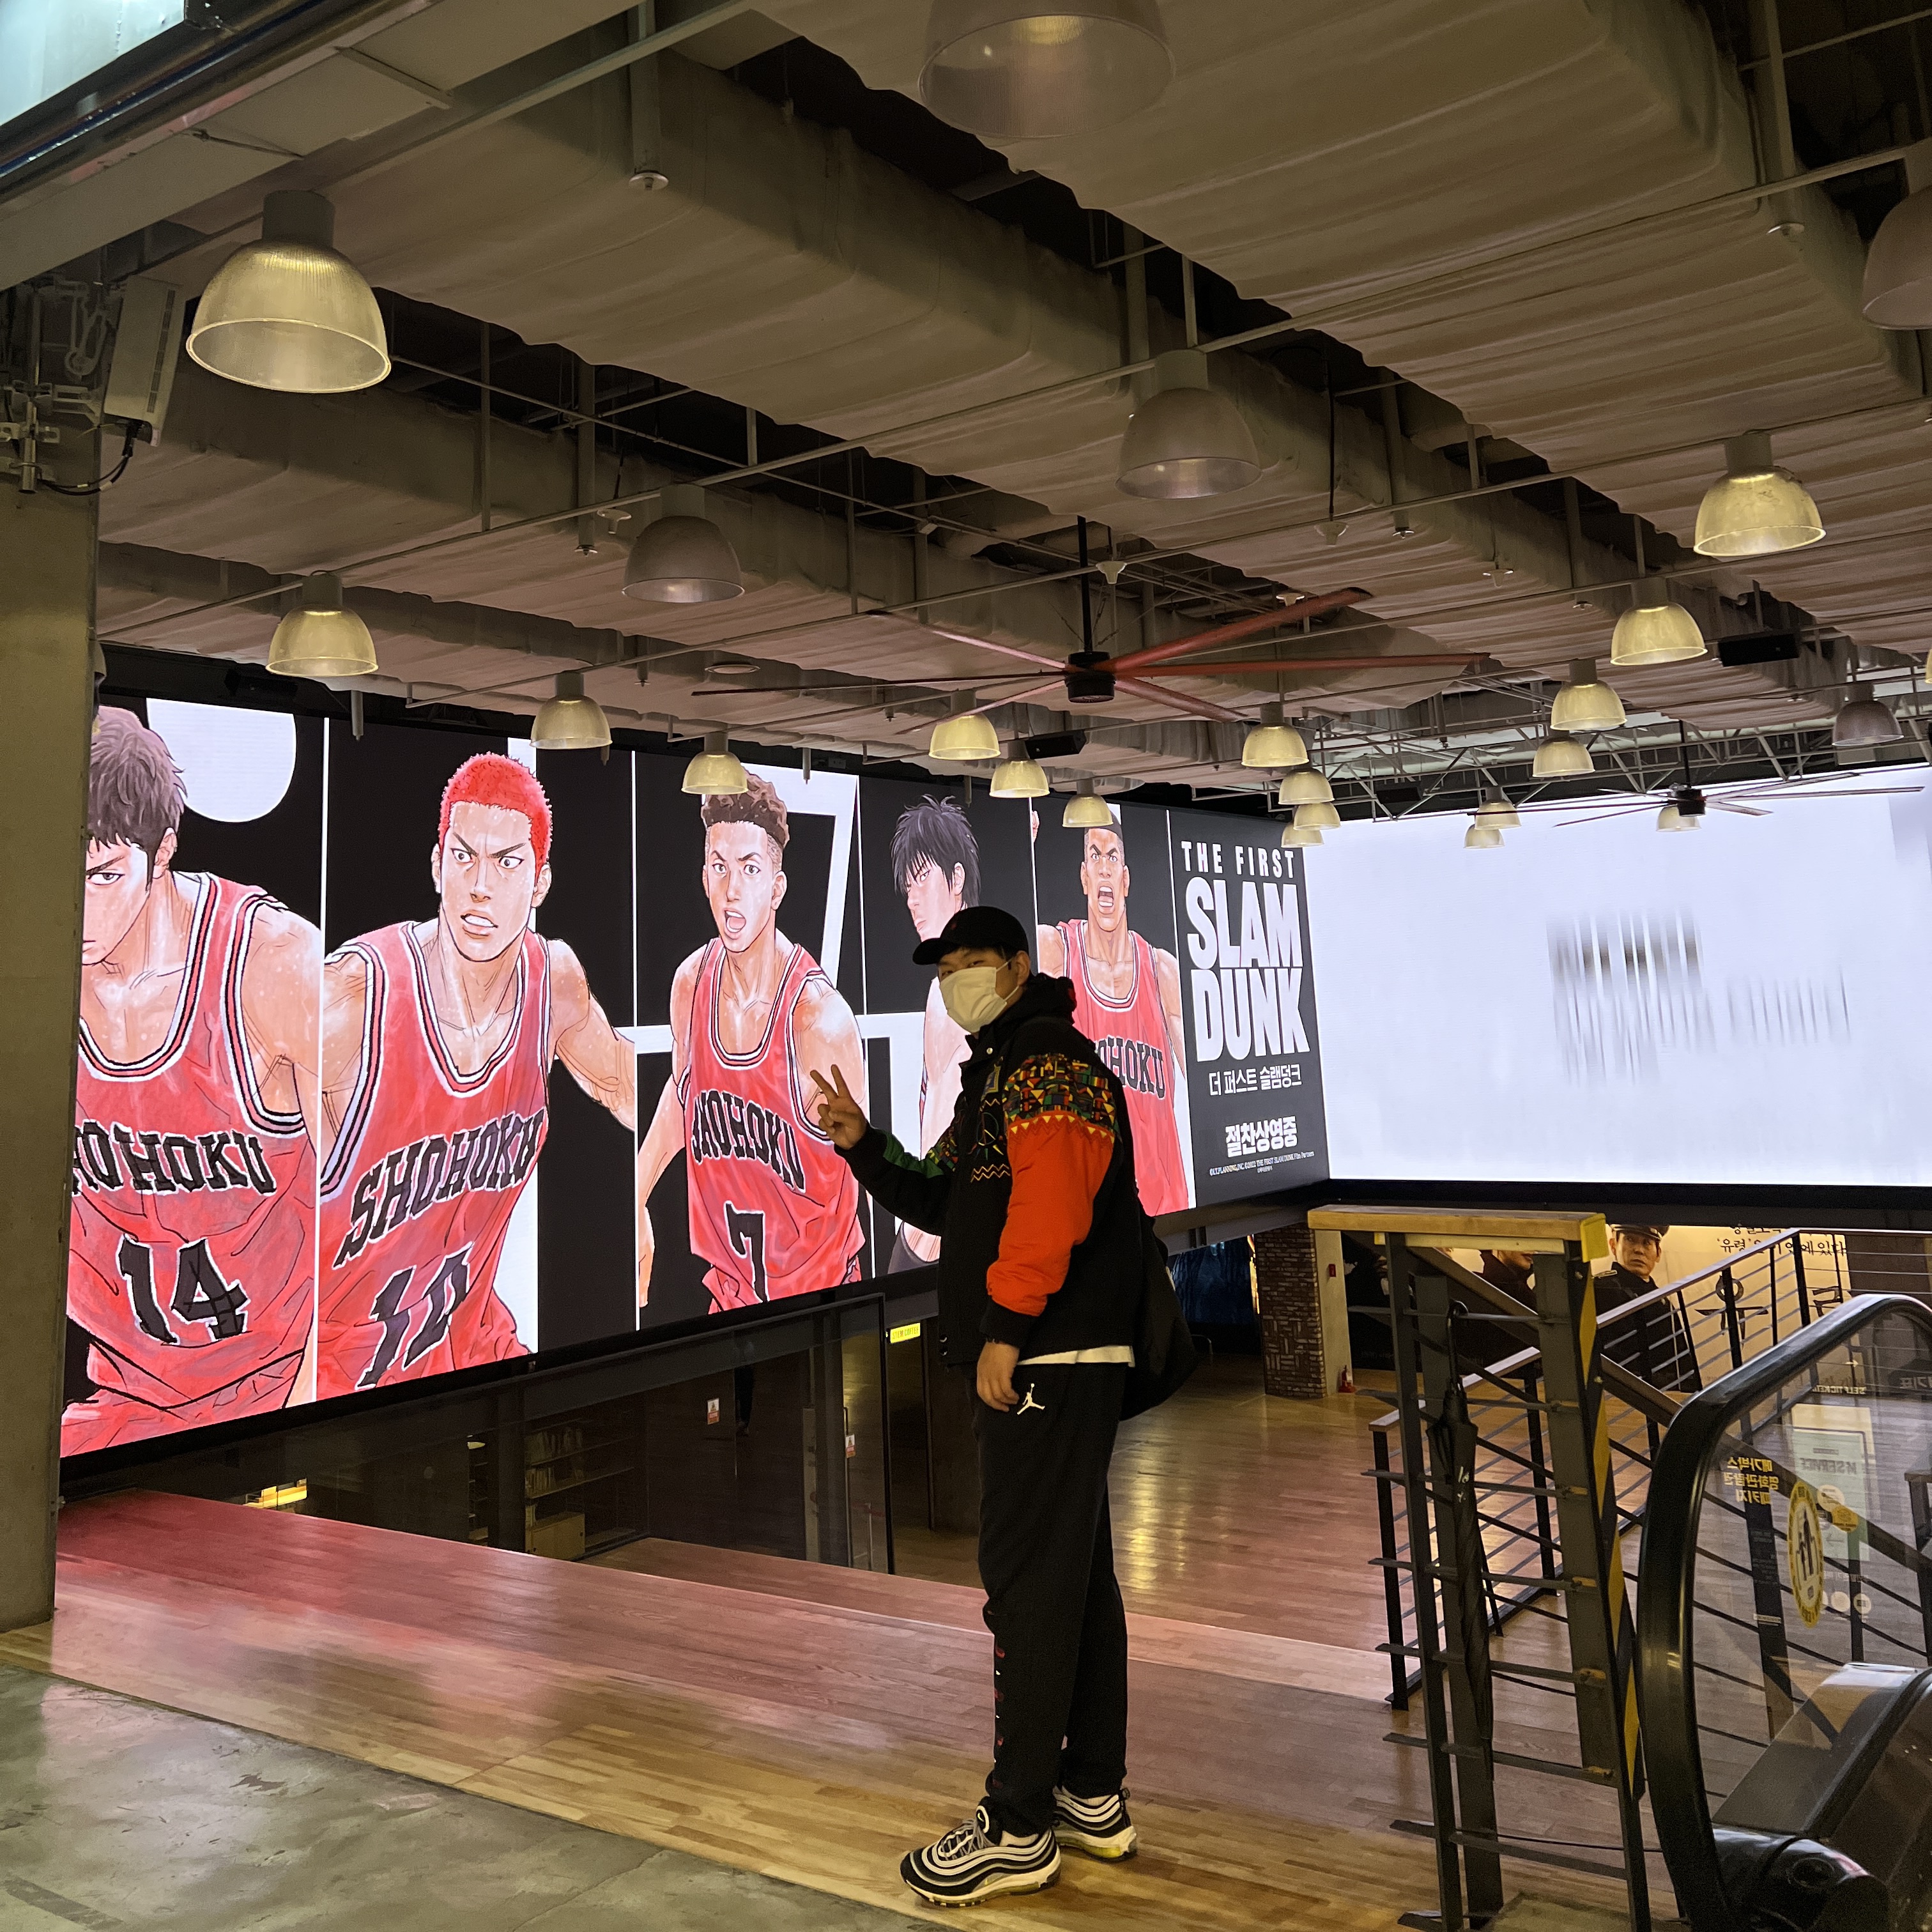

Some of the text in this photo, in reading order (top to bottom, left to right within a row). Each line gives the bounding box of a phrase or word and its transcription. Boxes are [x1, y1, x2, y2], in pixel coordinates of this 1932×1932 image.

[1181, 841, 1294, 878] THE FIRST
[1186, 877, 1303, 970] SLAM
[1190, 968, 1310, 1062] DUNK
[1096, 1035, 1166, 1099] OHOKU
[1209, 1064, 1302, 1096] 더 퍼스트 슬램덩크
[72, 1119, 276, 1195] OHOKU
[691, 1089, 806, 1193] SHOHOKU
[1225, 1116, 1298, 1158] 절찬상영중
[332, 1107, 546, 1269] SHOHOKU
[117, 1234, 250, 1345] 14
[724, 1200, 769, 1301] 7
[355, 1241, 474, 1390] 10
[905, 1327, 919, 1337] COFFEE
